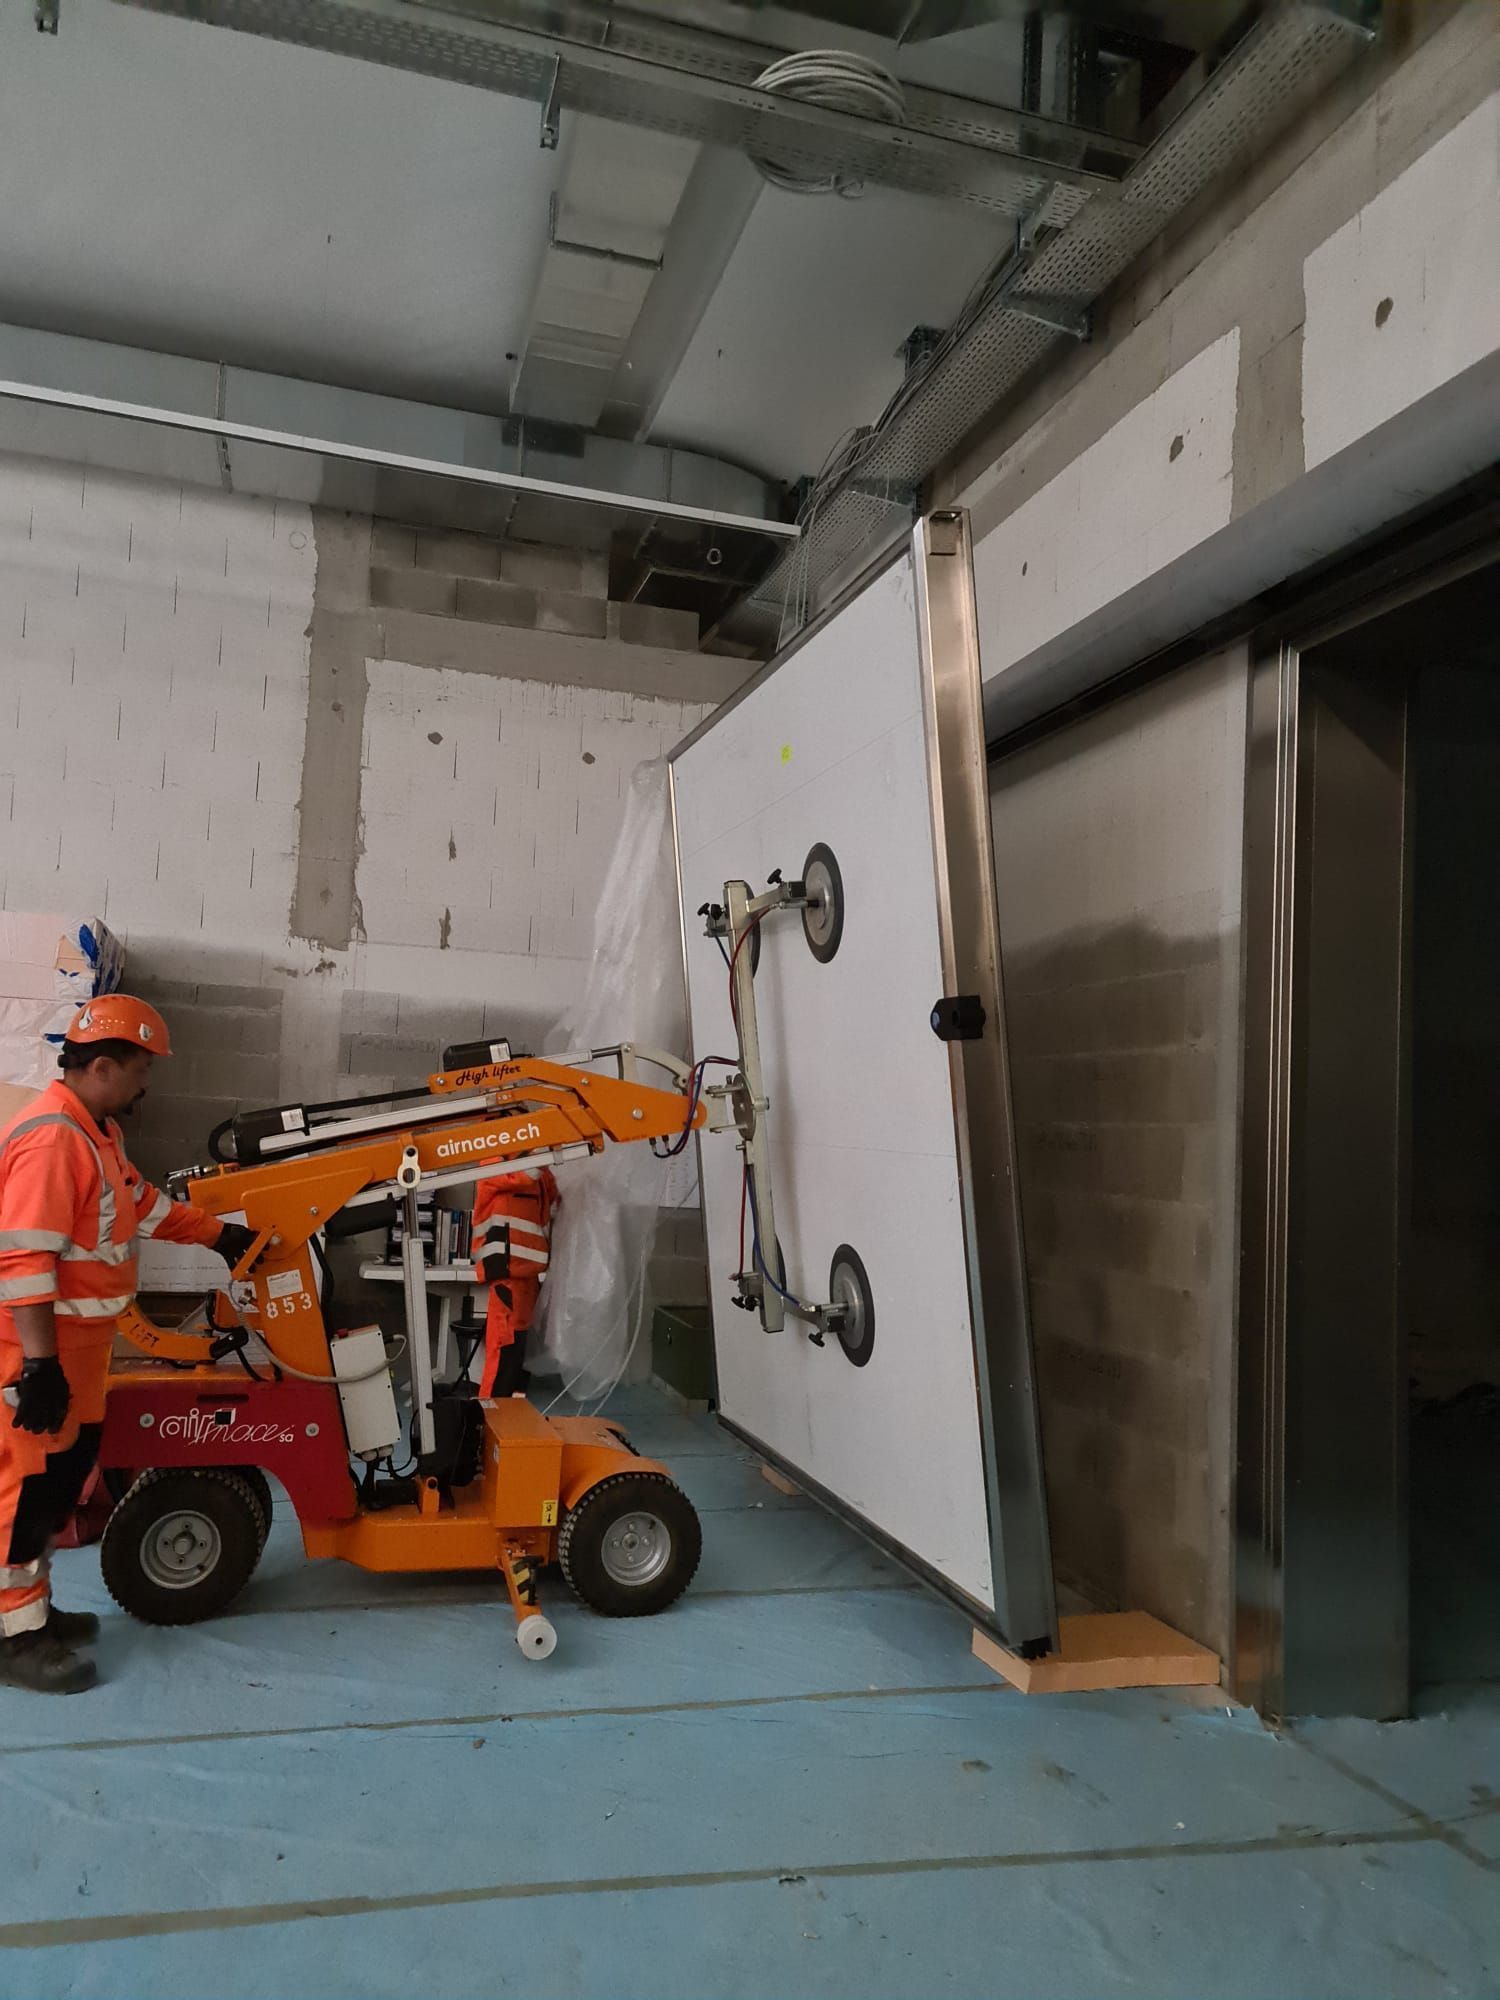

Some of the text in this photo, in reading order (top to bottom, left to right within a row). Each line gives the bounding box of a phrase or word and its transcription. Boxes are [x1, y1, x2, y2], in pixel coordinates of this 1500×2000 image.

[456, 1063, 521, 1086] High lifter
[436, 1123, 540, 1157] airnace.ch
[278, 1433, 295, 1443] sa
